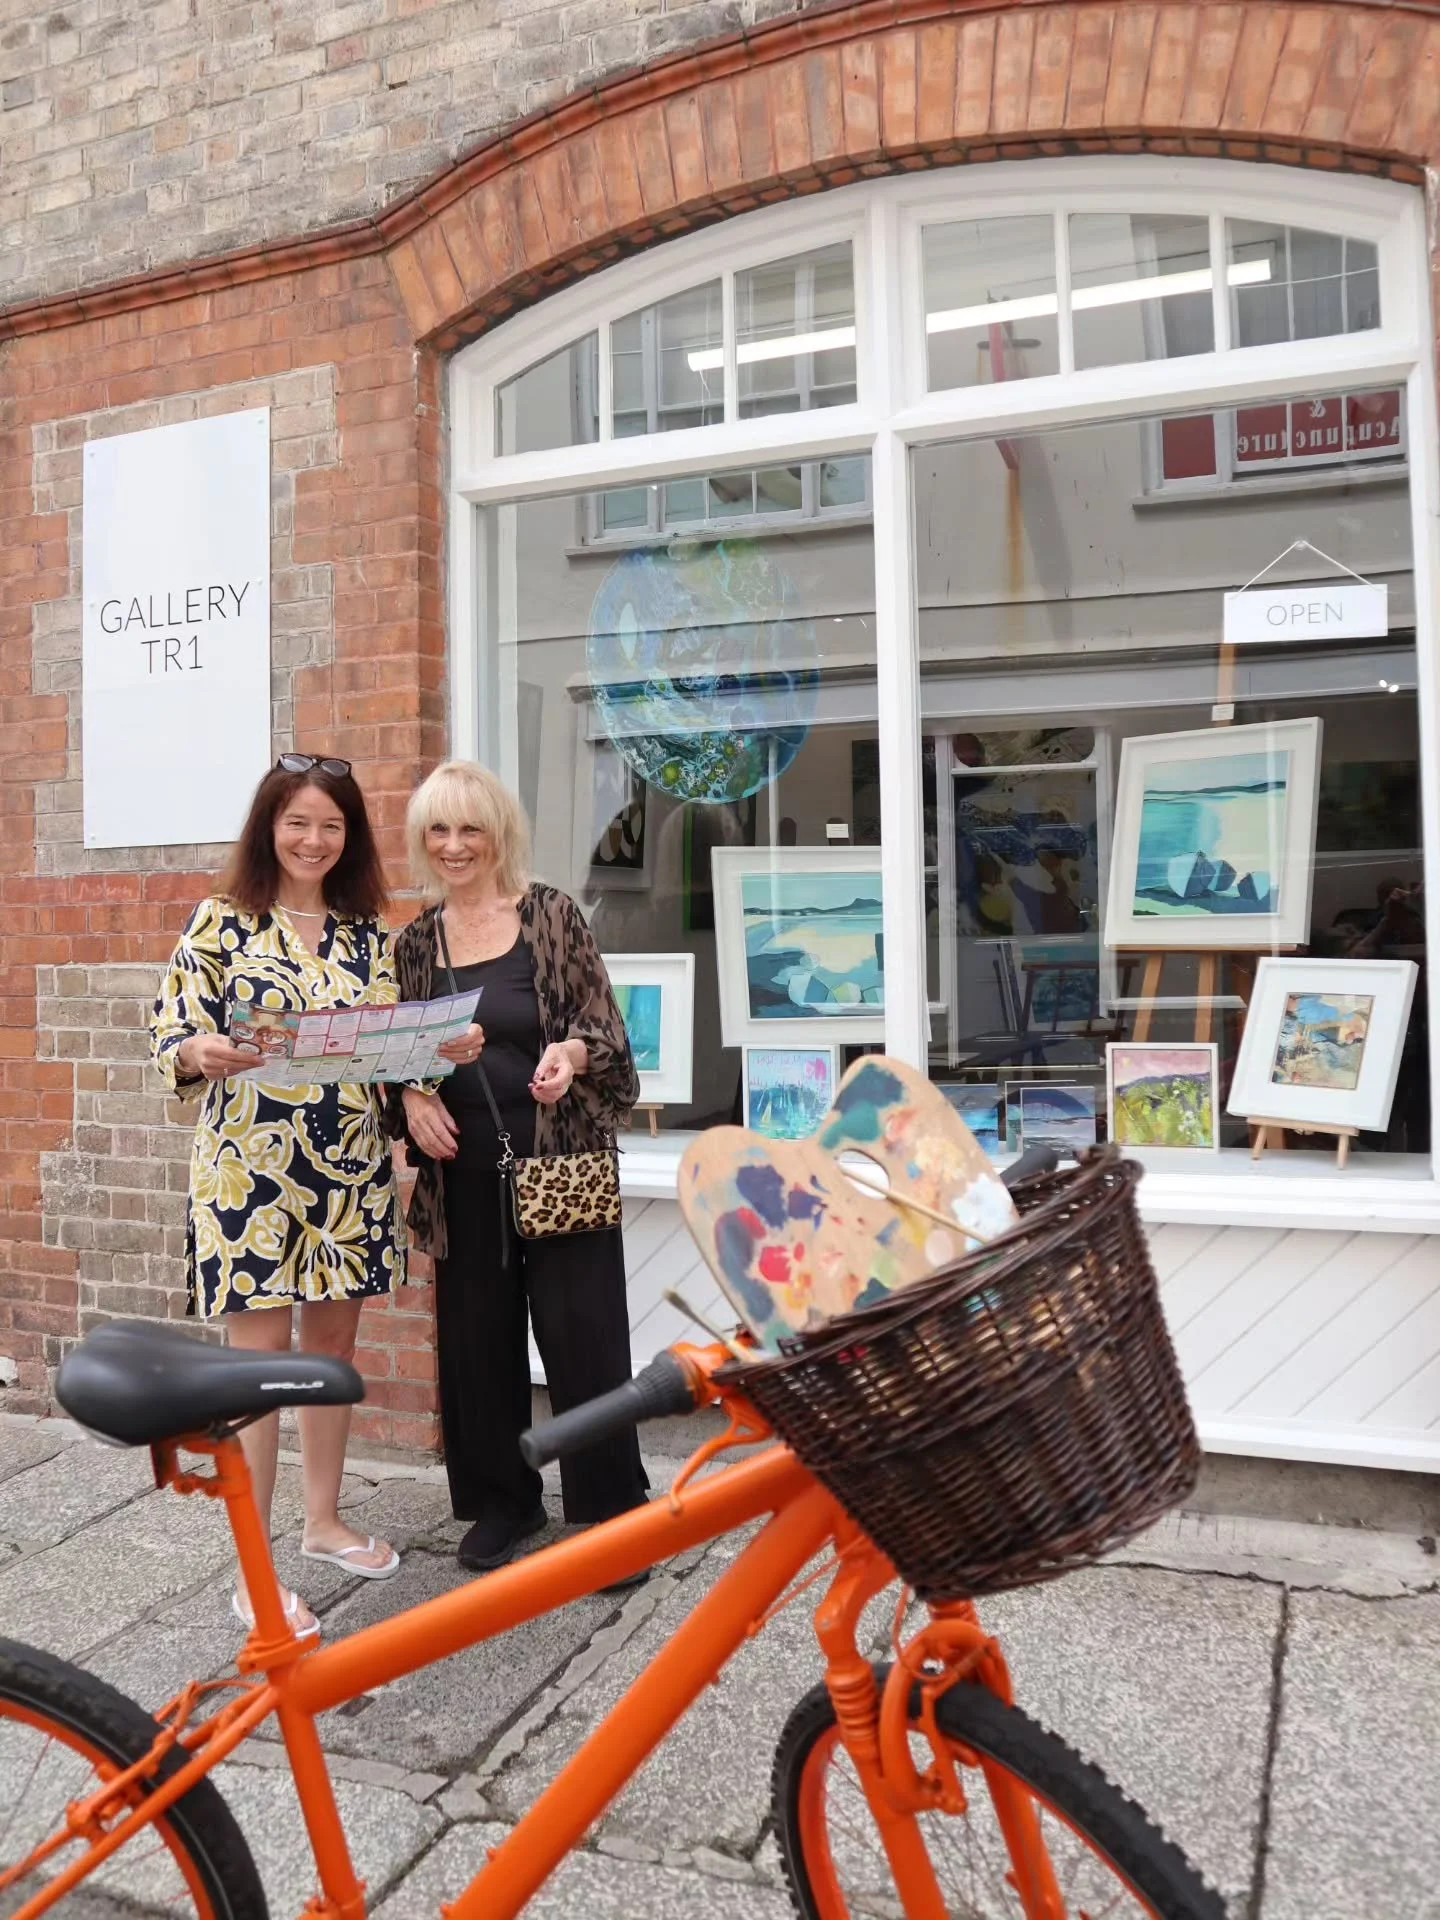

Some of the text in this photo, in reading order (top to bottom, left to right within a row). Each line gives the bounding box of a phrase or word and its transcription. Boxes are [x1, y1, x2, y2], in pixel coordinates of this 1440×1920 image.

[100, 581, 250, 634] GALLERY
[1266, 601, 1343, 626] OPEN
[140, 635, 203, 674] TR1
